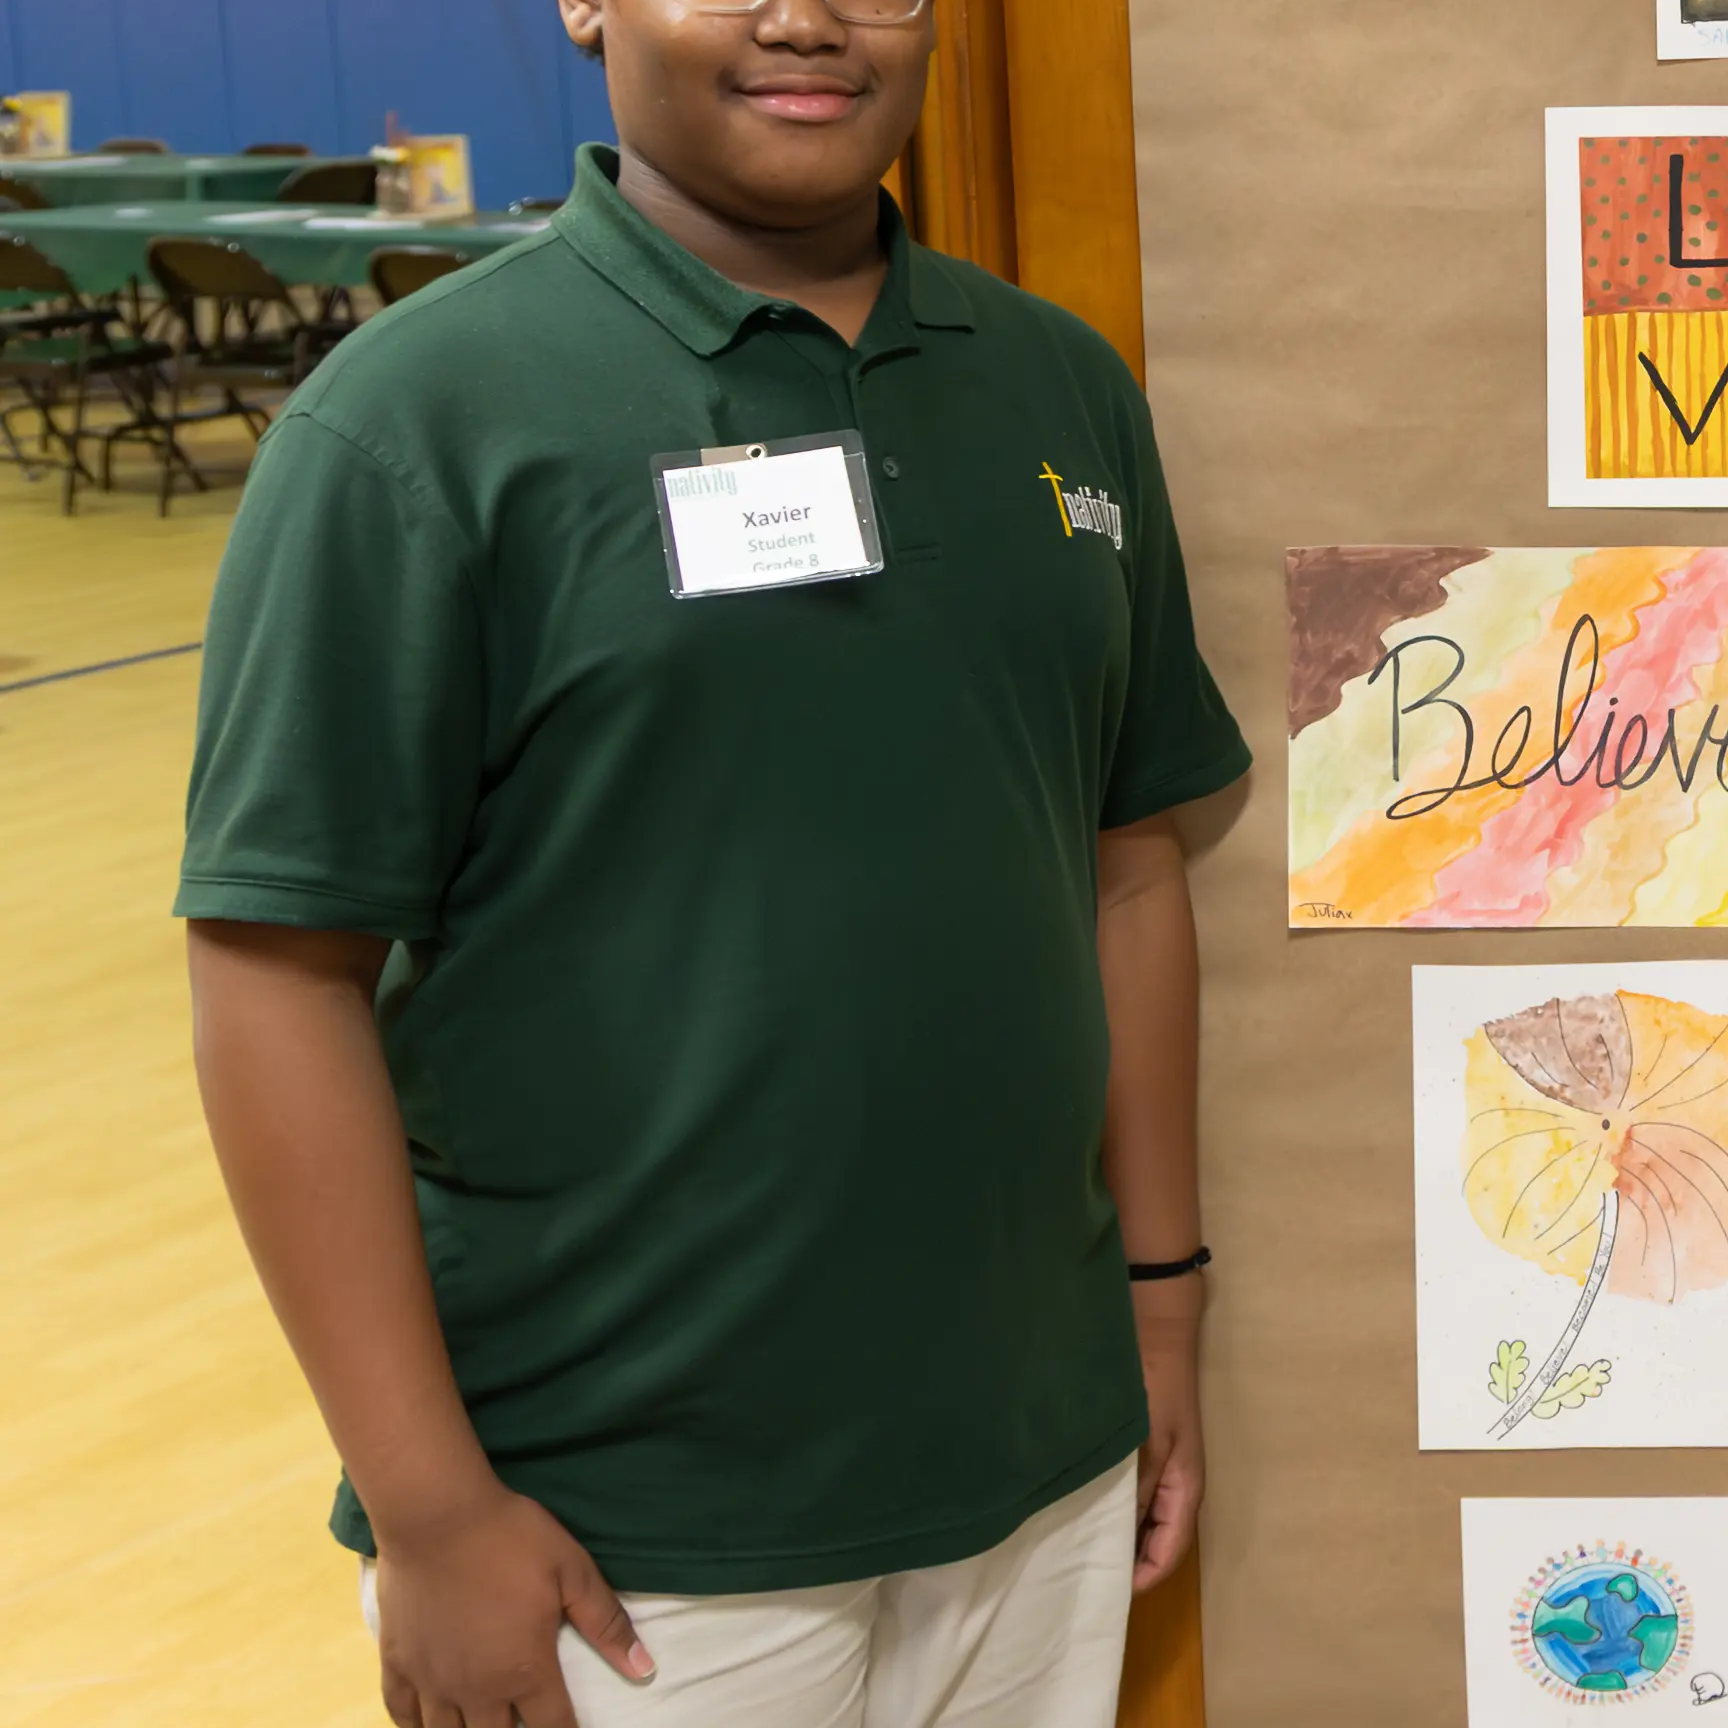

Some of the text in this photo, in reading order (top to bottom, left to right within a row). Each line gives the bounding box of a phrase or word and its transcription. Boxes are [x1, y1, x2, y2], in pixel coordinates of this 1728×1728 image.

[668, 466, 738, 496] nativity
[742, 505, 812, 528] Xavier
[747, 532, 818, 552] Student
[808, 553, 820, 567] 8
